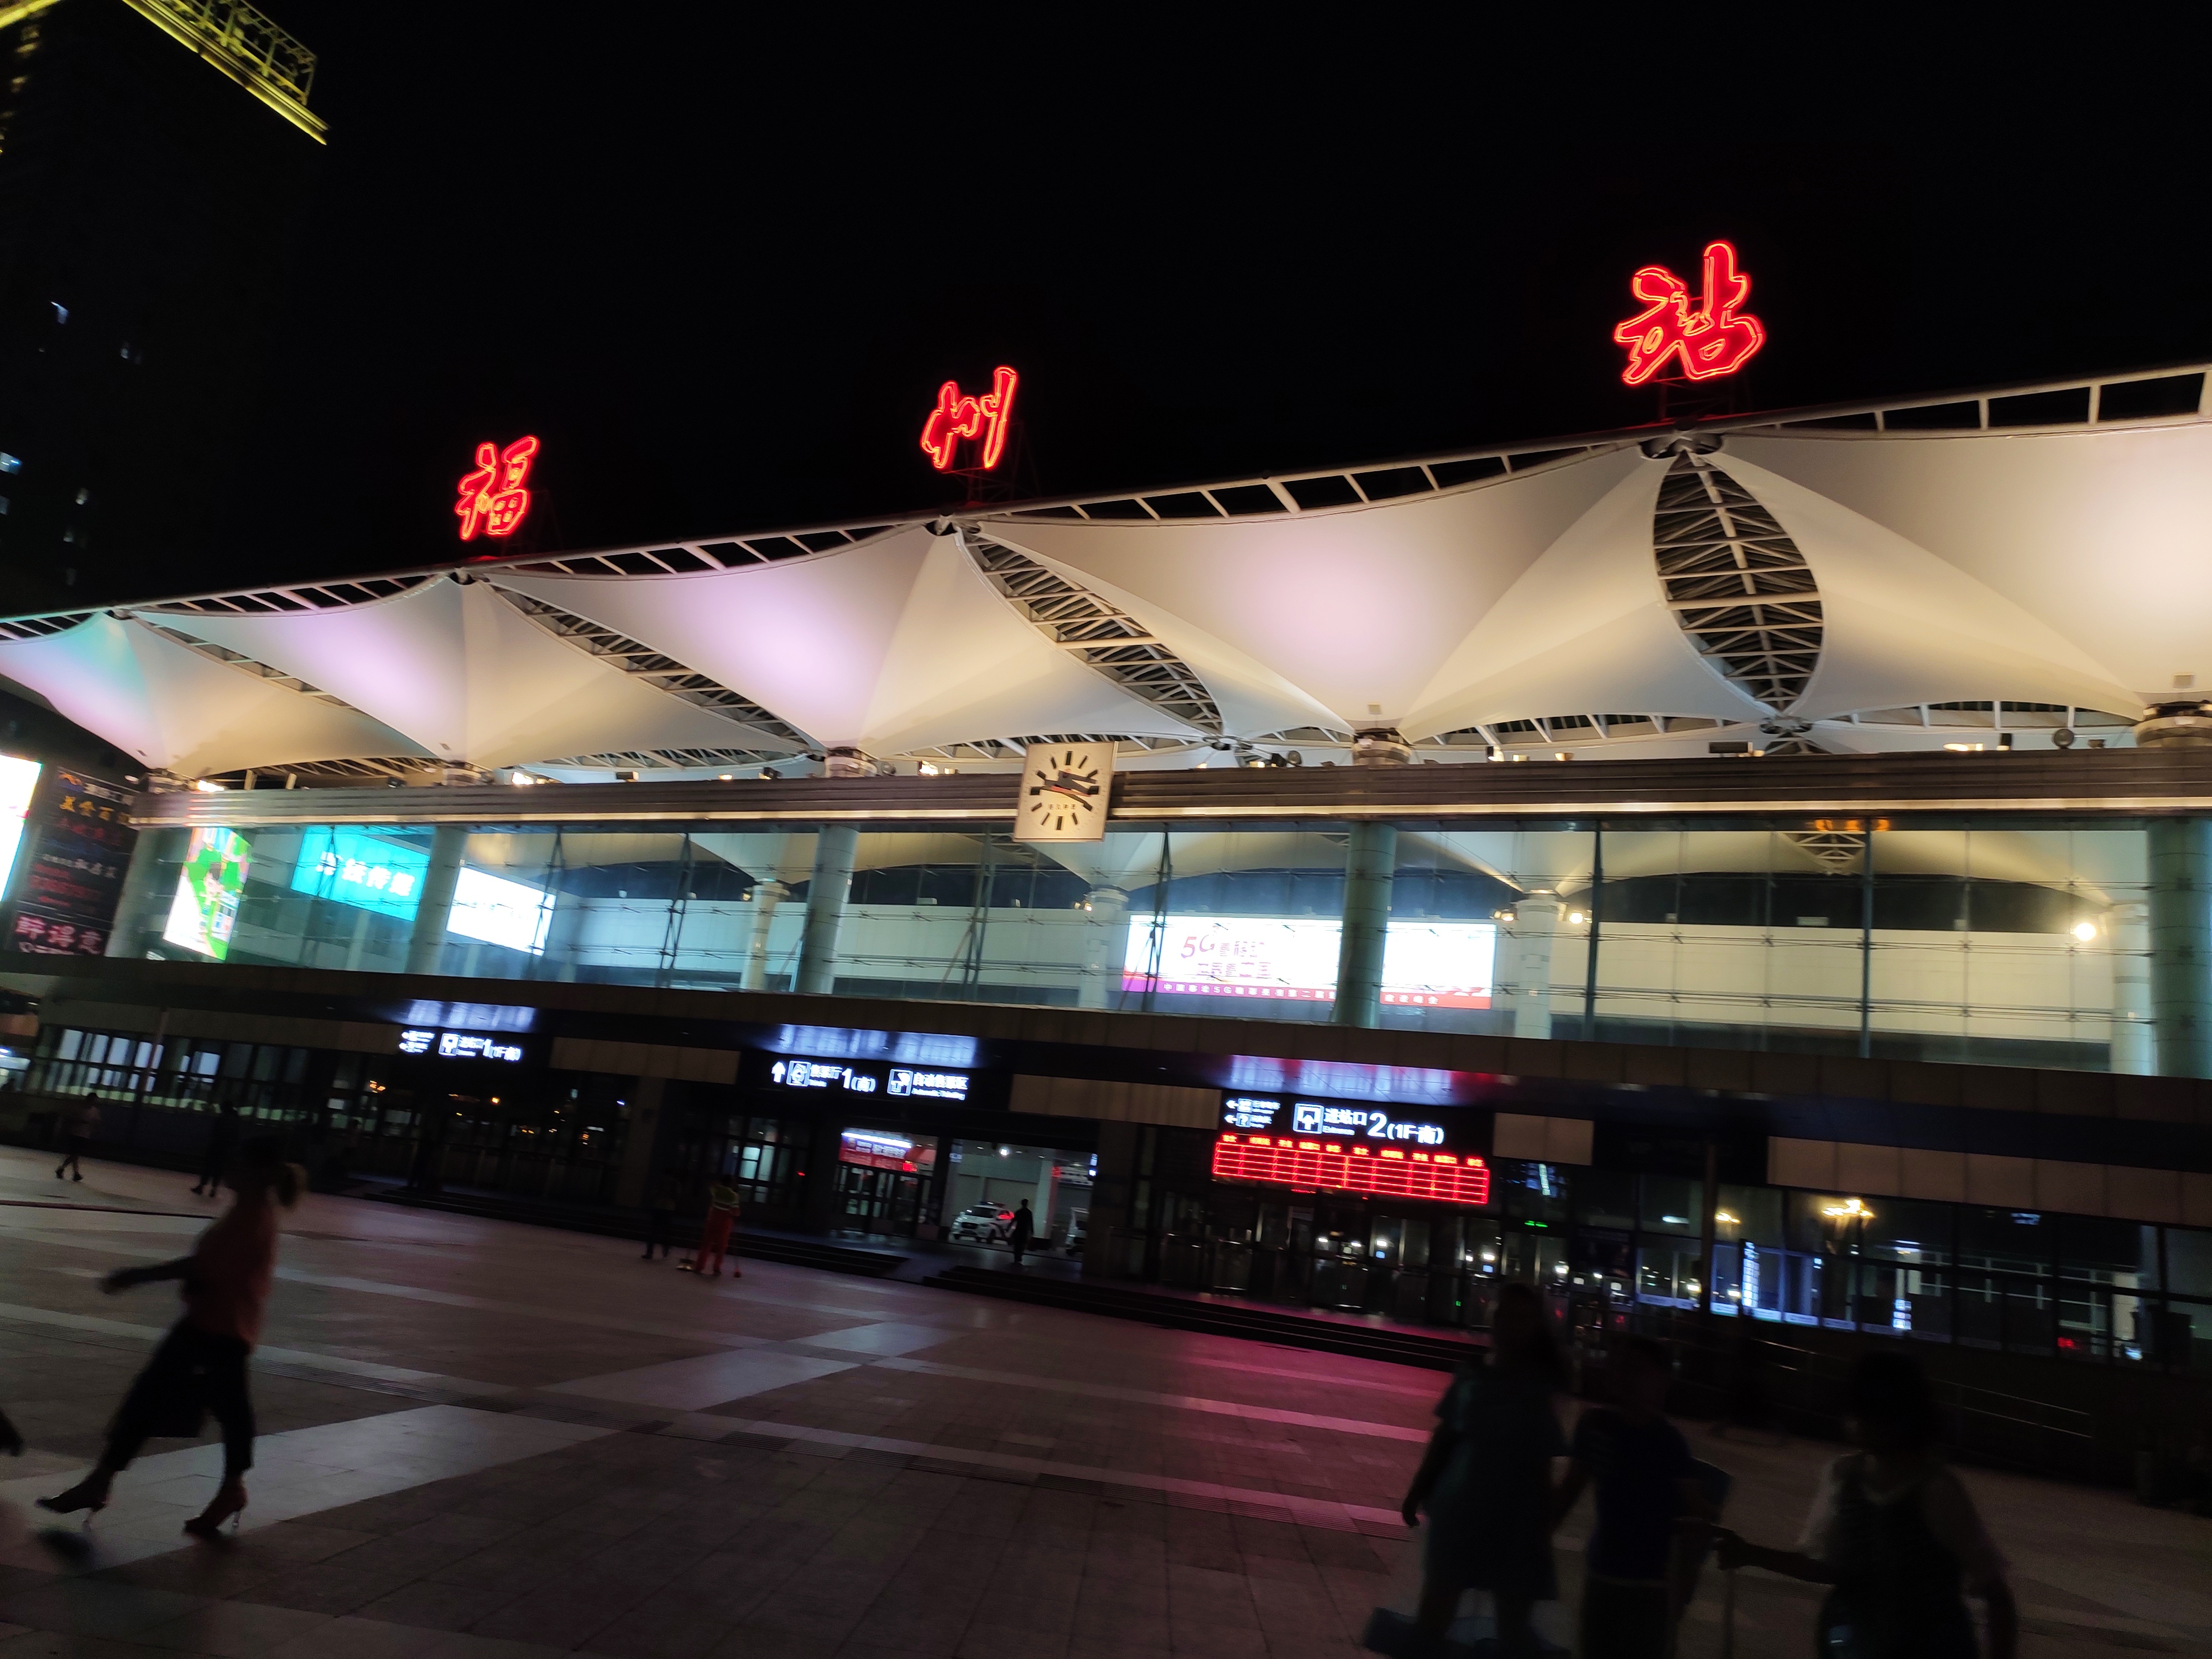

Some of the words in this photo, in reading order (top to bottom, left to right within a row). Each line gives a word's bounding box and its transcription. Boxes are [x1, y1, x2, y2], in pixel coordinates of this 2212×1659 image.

[456, 436, 537, 540] 福
[922, 367, 1016, 468] 州
[1614, 243, 1763, 384] 站
